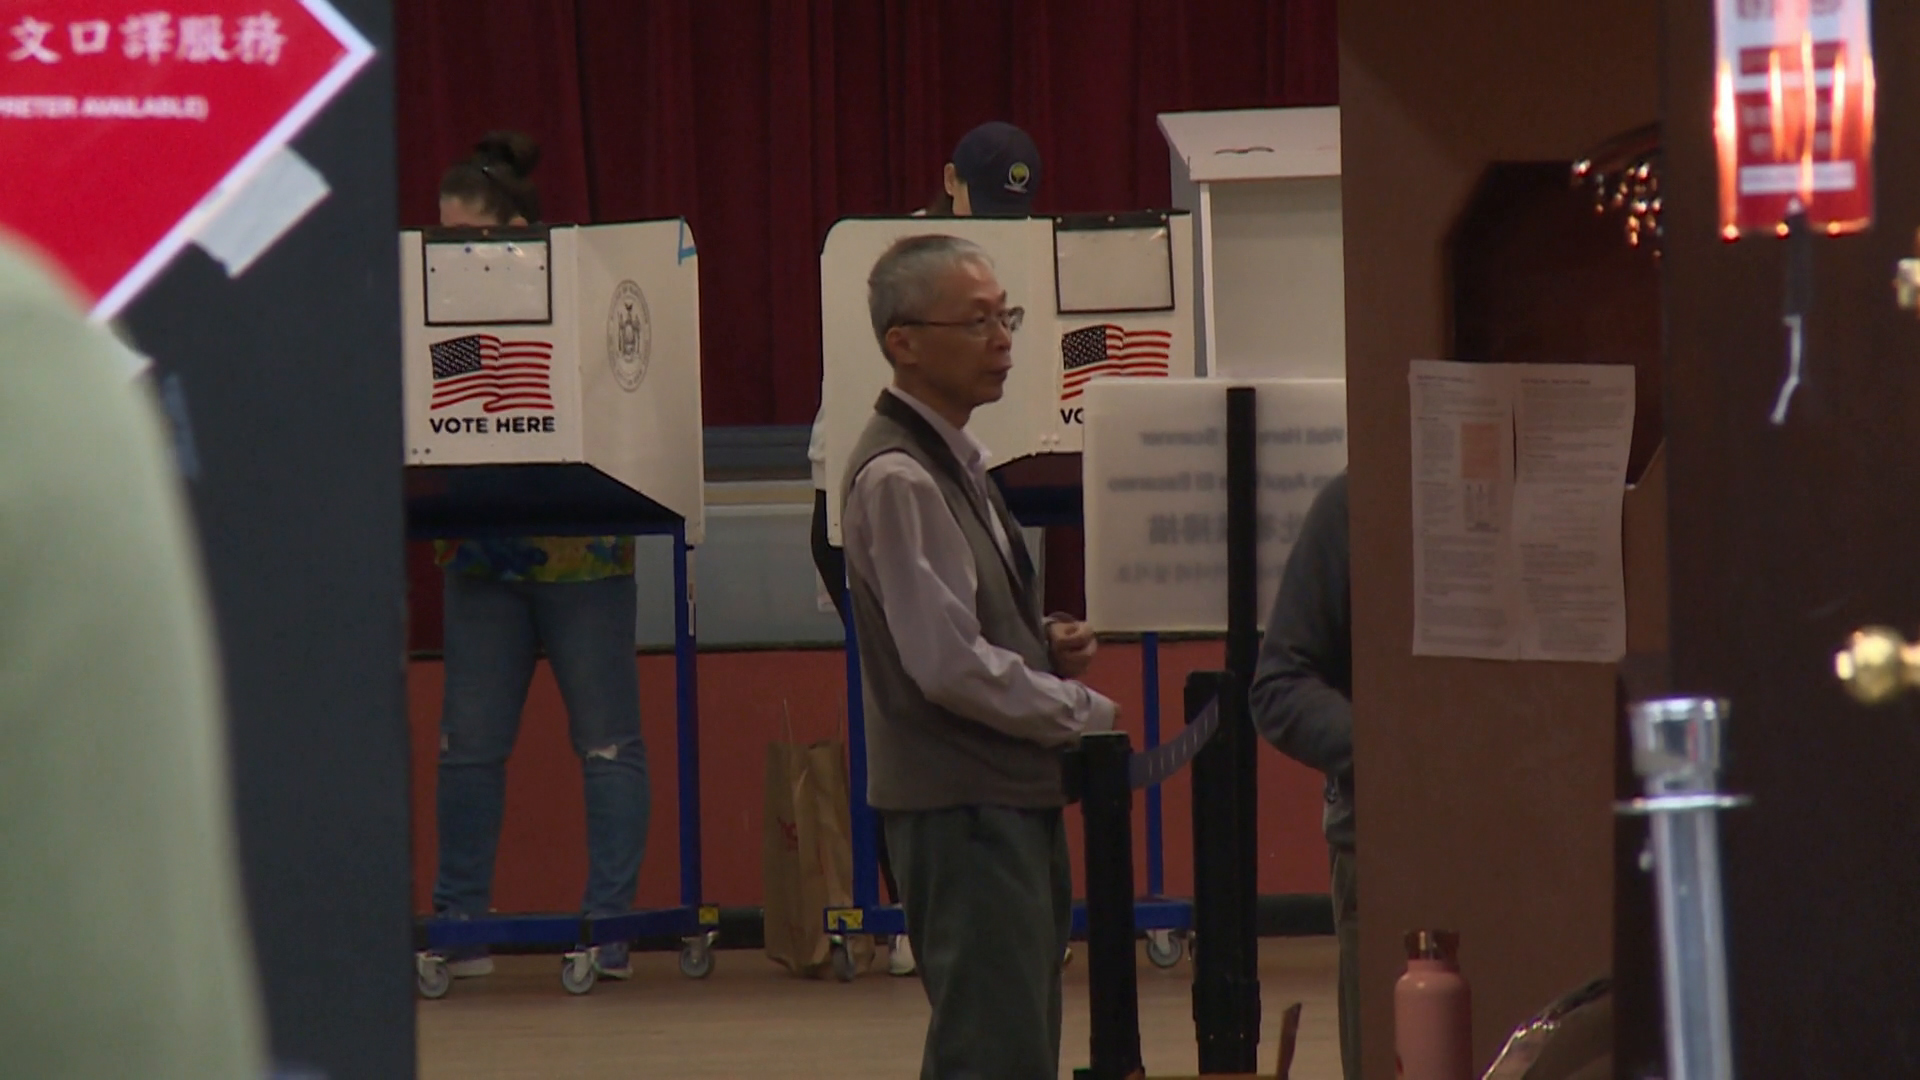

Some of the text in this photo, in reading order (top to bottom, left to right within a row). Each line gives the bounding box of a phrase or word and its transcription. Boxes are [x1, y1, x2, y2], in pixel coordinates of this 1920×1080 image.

[8, 11, 287, 66] 文口譯服務
[82, 95, 209, 121] AVAILABLE)
[429, 416, 556, 434] VOTE HERE
[1060, 407, 1084, 424] VO
